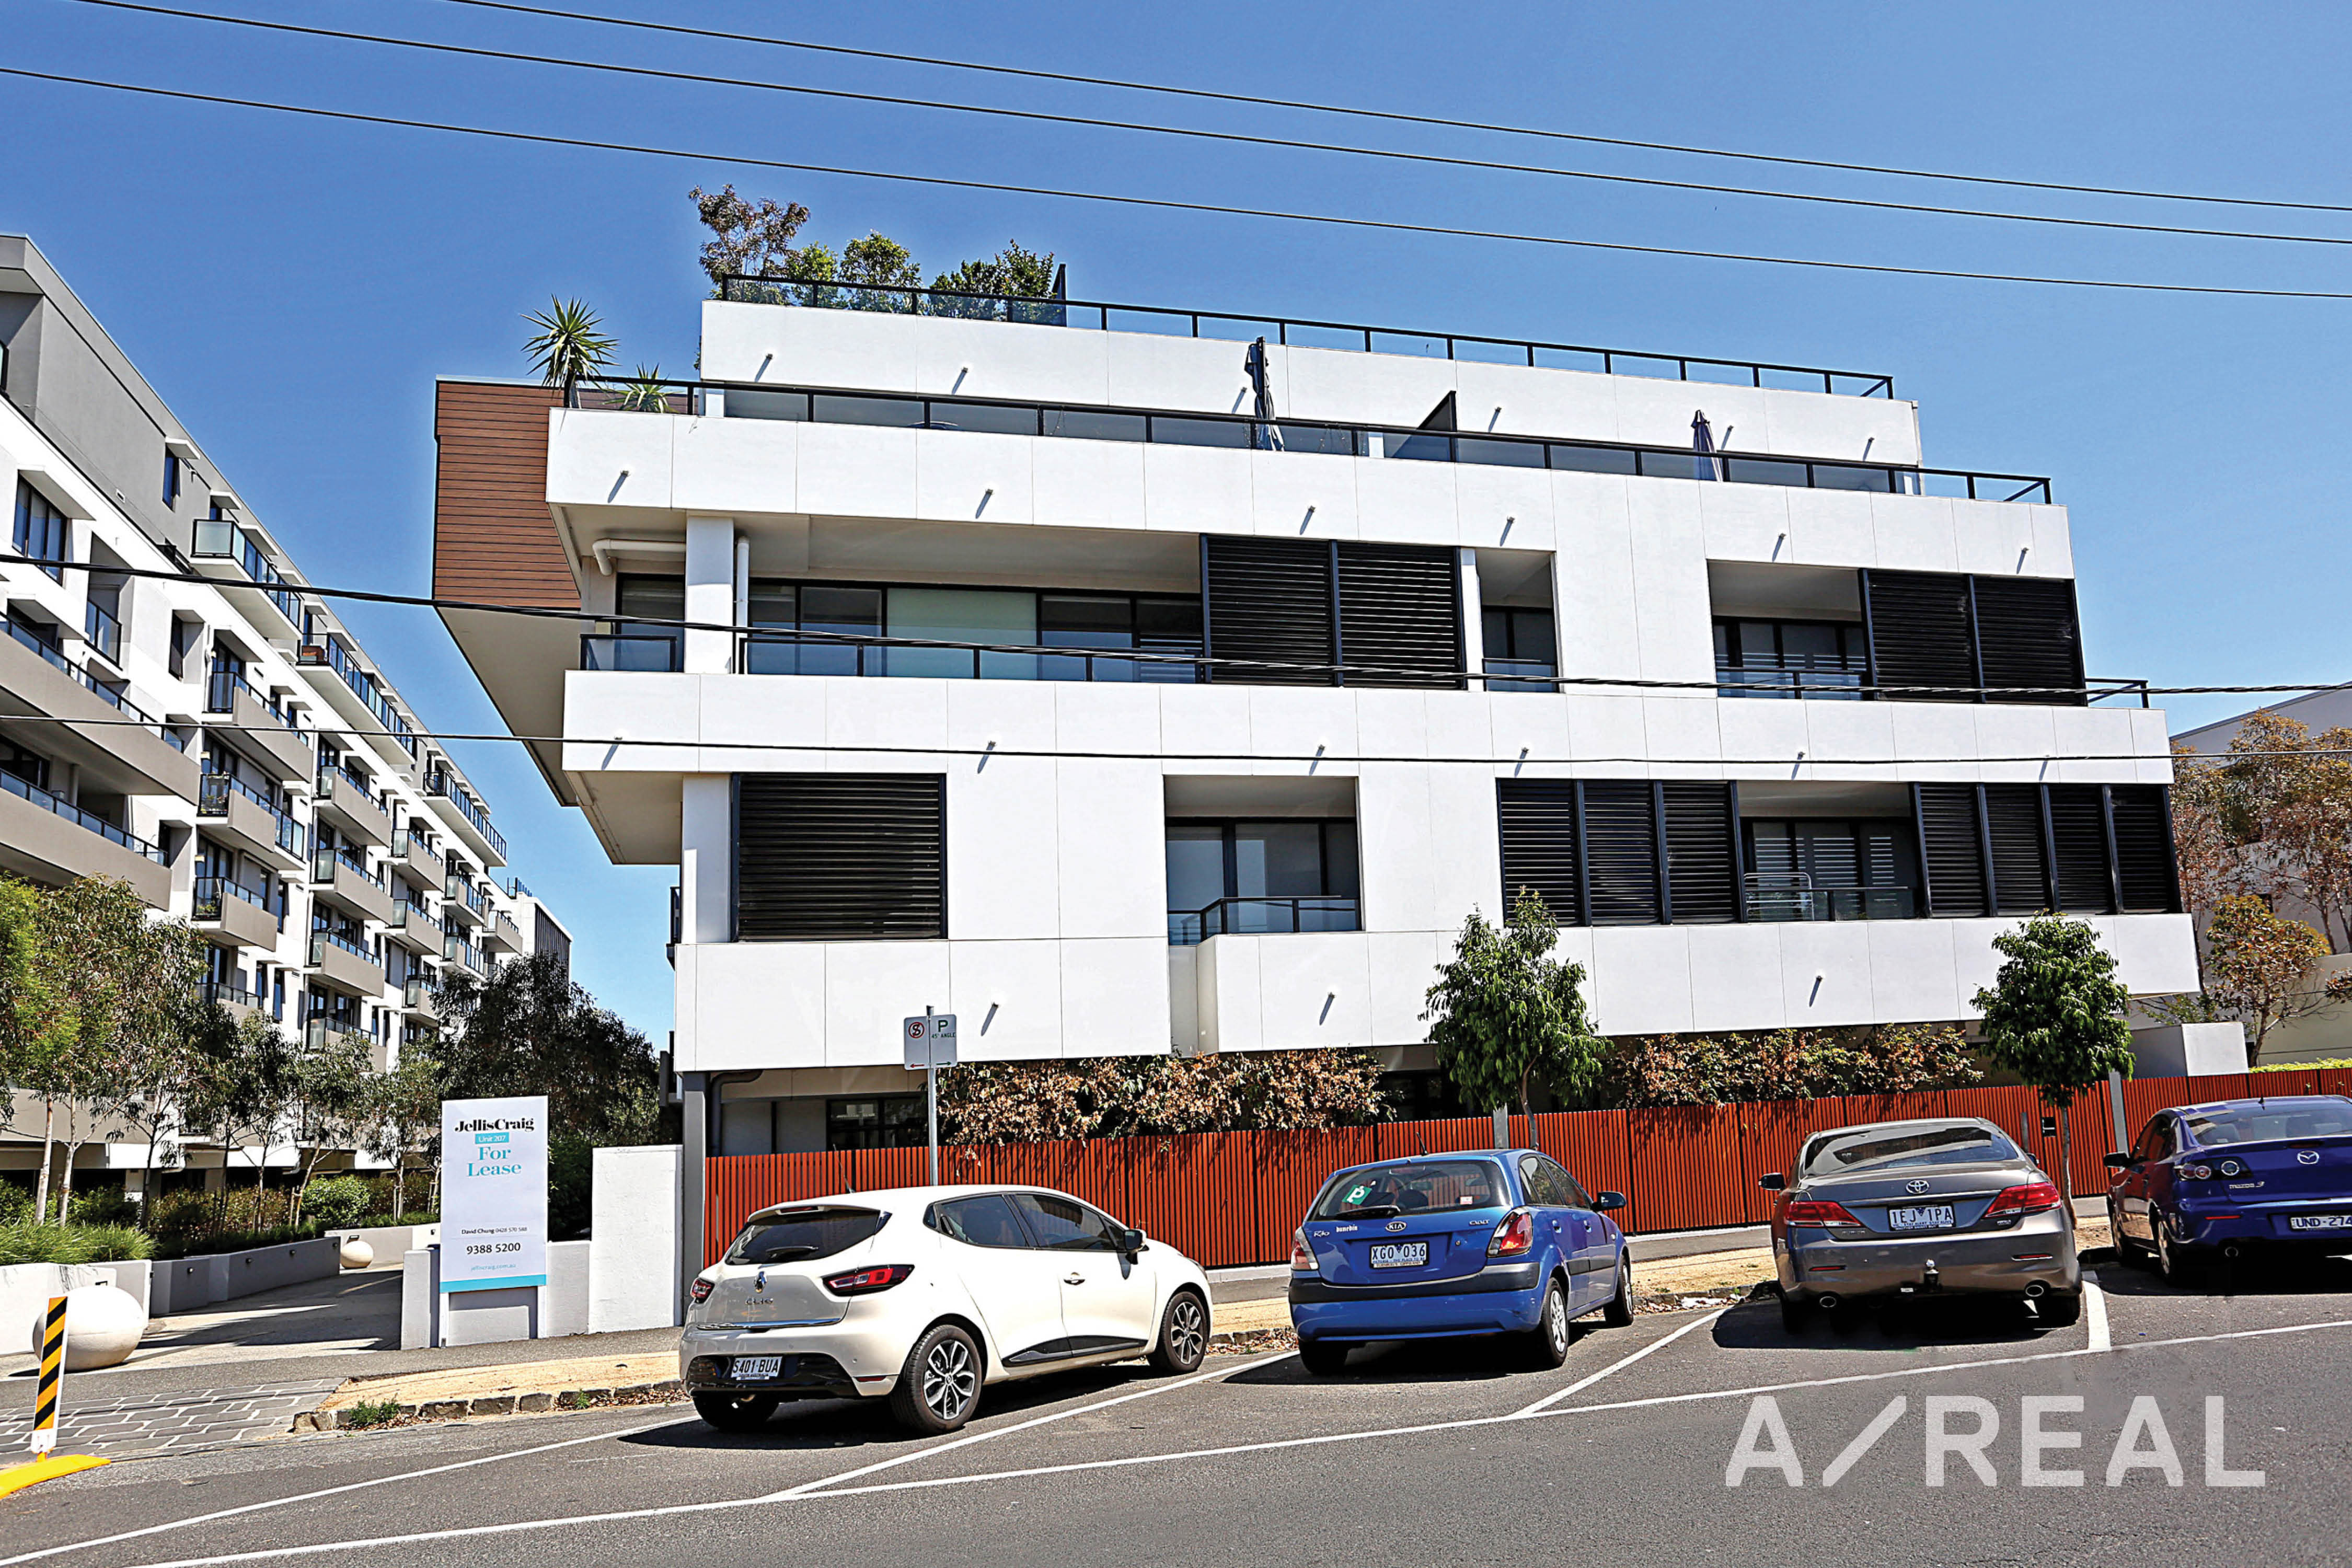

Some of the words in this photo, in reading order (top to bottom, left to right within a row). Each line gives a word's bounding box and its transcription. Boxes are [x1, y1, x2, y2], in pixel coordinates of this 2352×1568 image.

[938, 1019, 949, 1032] P
[455, 1117, 535, 1132] JellisCraig
[478, 1146, 512, 1160] For
[466, 1163, 522, 1177] Lease
[1892, 1210, 1916, 1224] 1EJ
[1927, 1207, 1952, 1221] 1PA
[466, 1244, 492, 1255] 9388
[495, 1242, 521, 1253] 5200
[1403, 1244, 1426, 1258] 036
